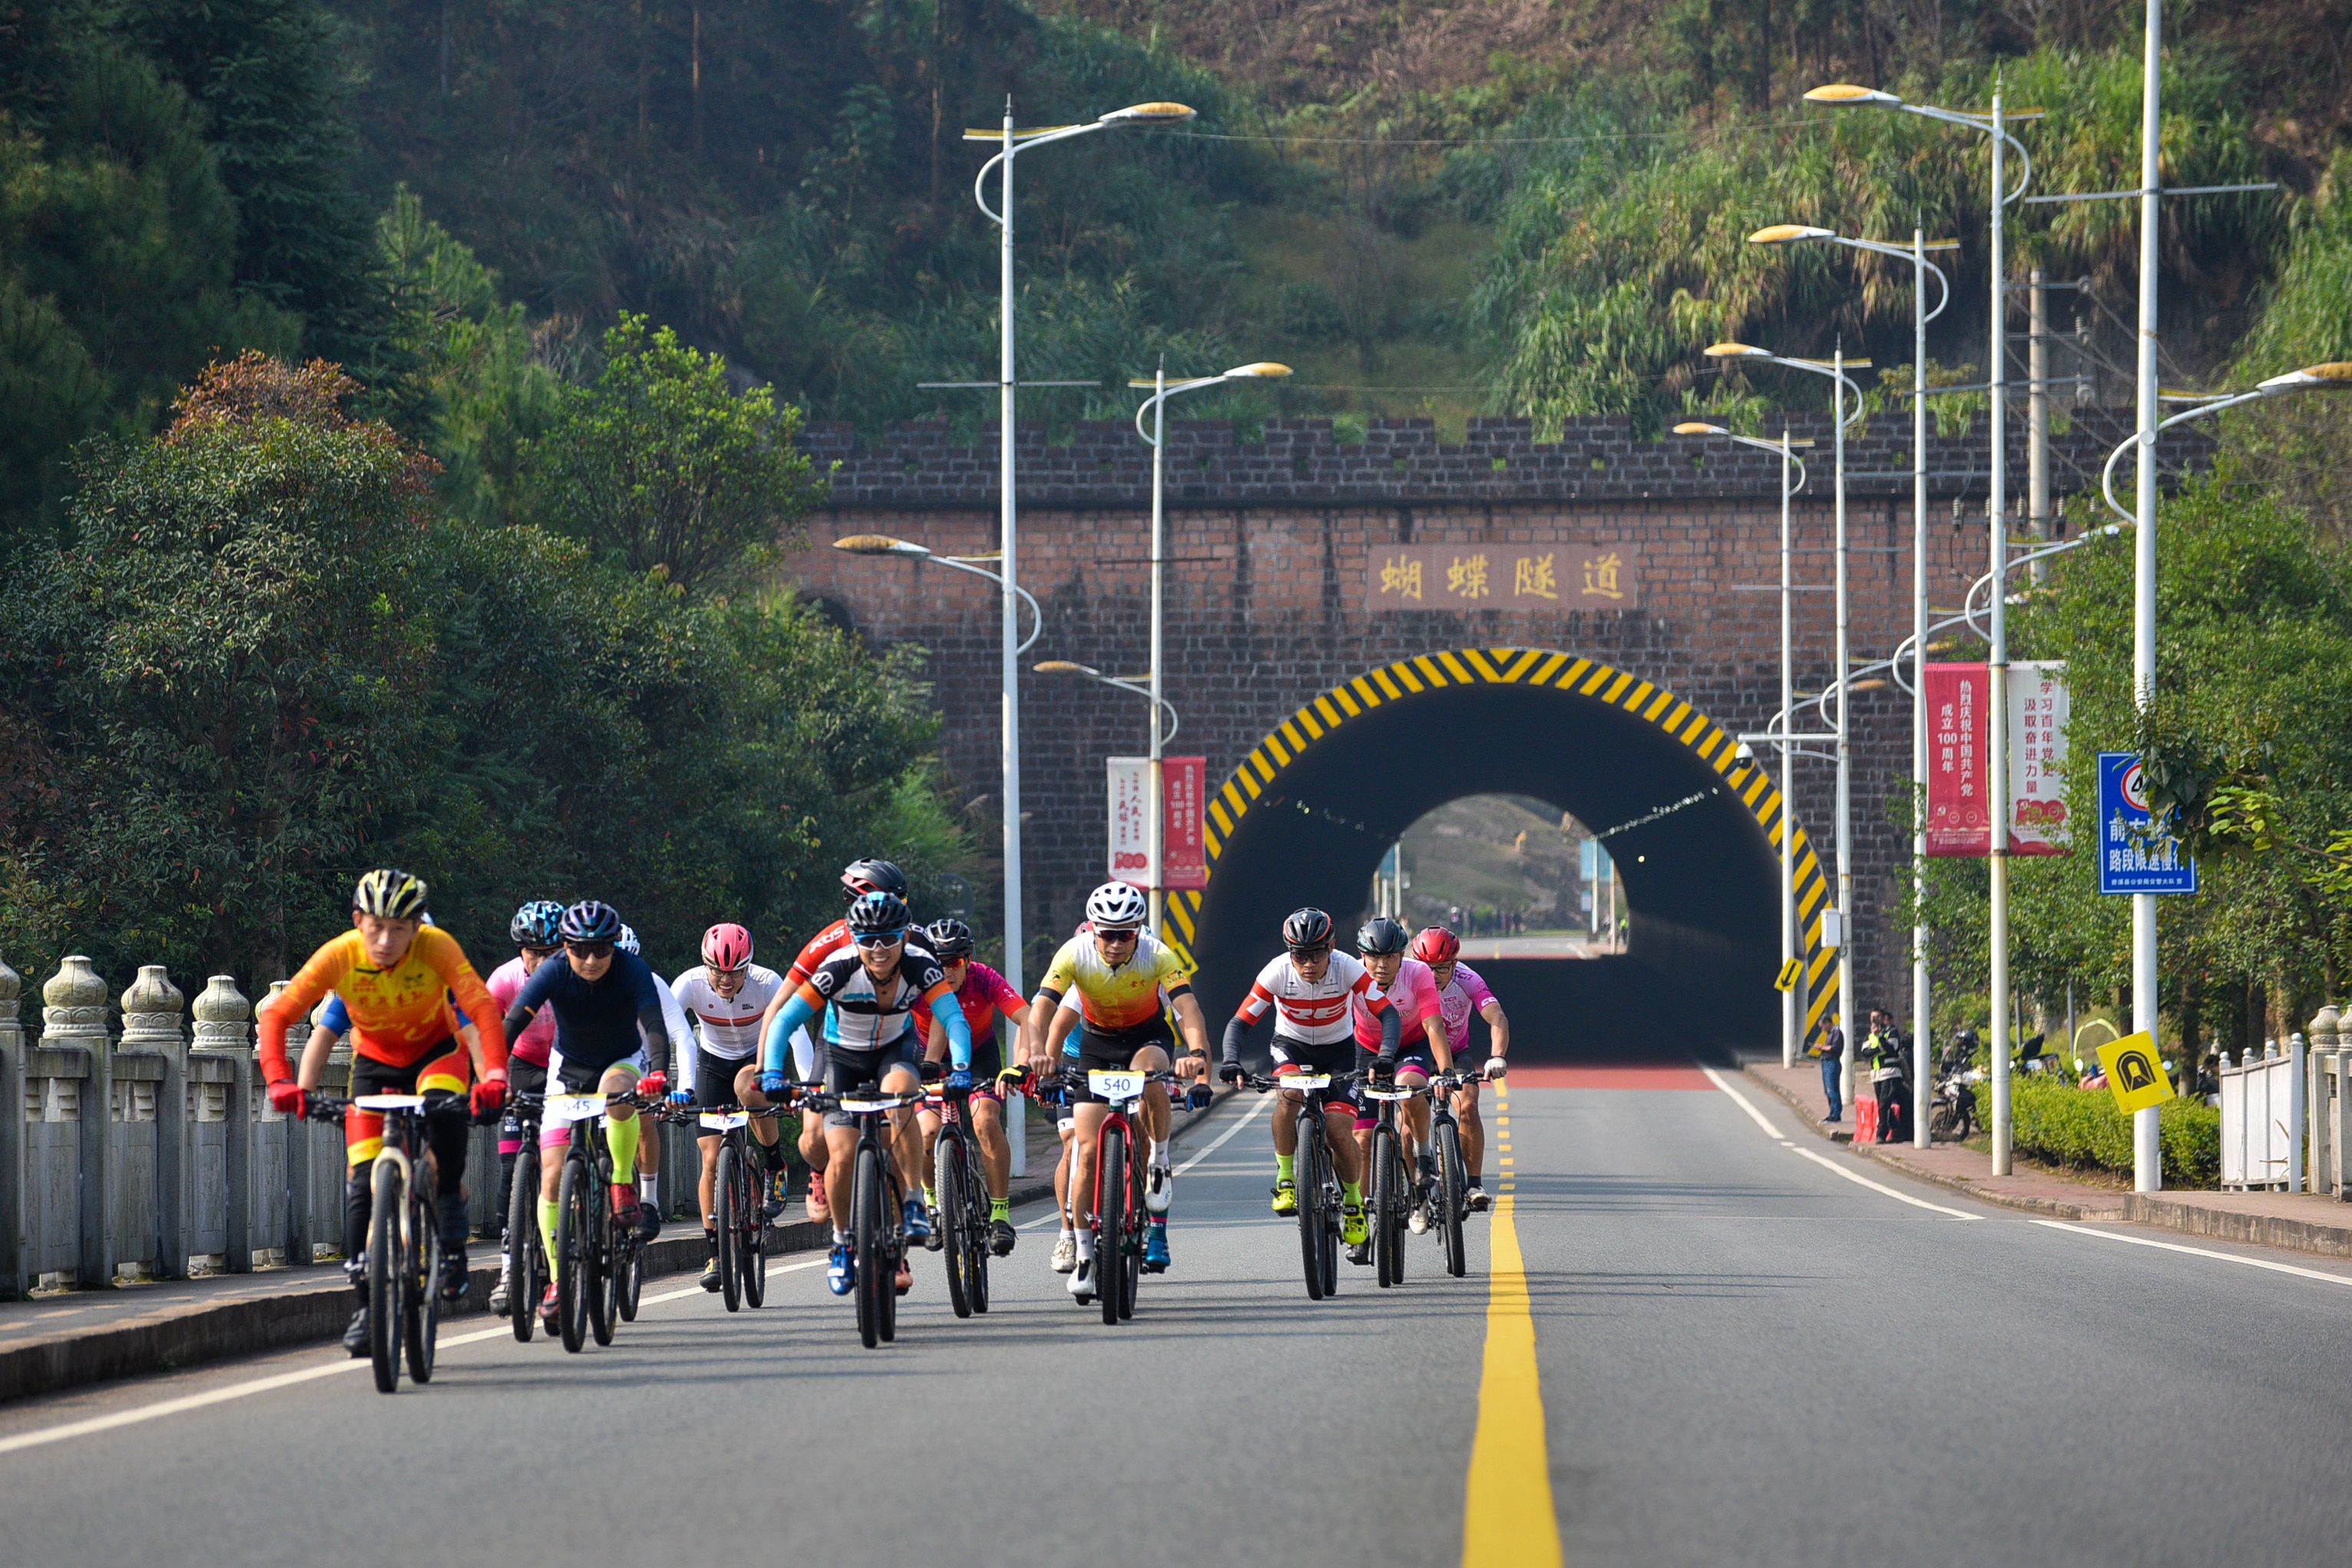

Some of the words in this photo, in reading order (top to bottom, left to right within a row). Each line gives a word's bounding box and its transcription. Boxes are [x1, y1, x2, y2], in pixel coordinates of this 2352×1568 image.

[1380, 552, 1623, 600] 蝴蝶隧道
[1937, 703, 1957, 774] 成立100周年
[1960, 680, 1973, 797] 热烈庆祝中国共产党
[2024, 698, 2037, 793] 汲取奋进力量
[564, 1100, 590, 1112] 545
[1103, 1078, 1130, 1091] 540
